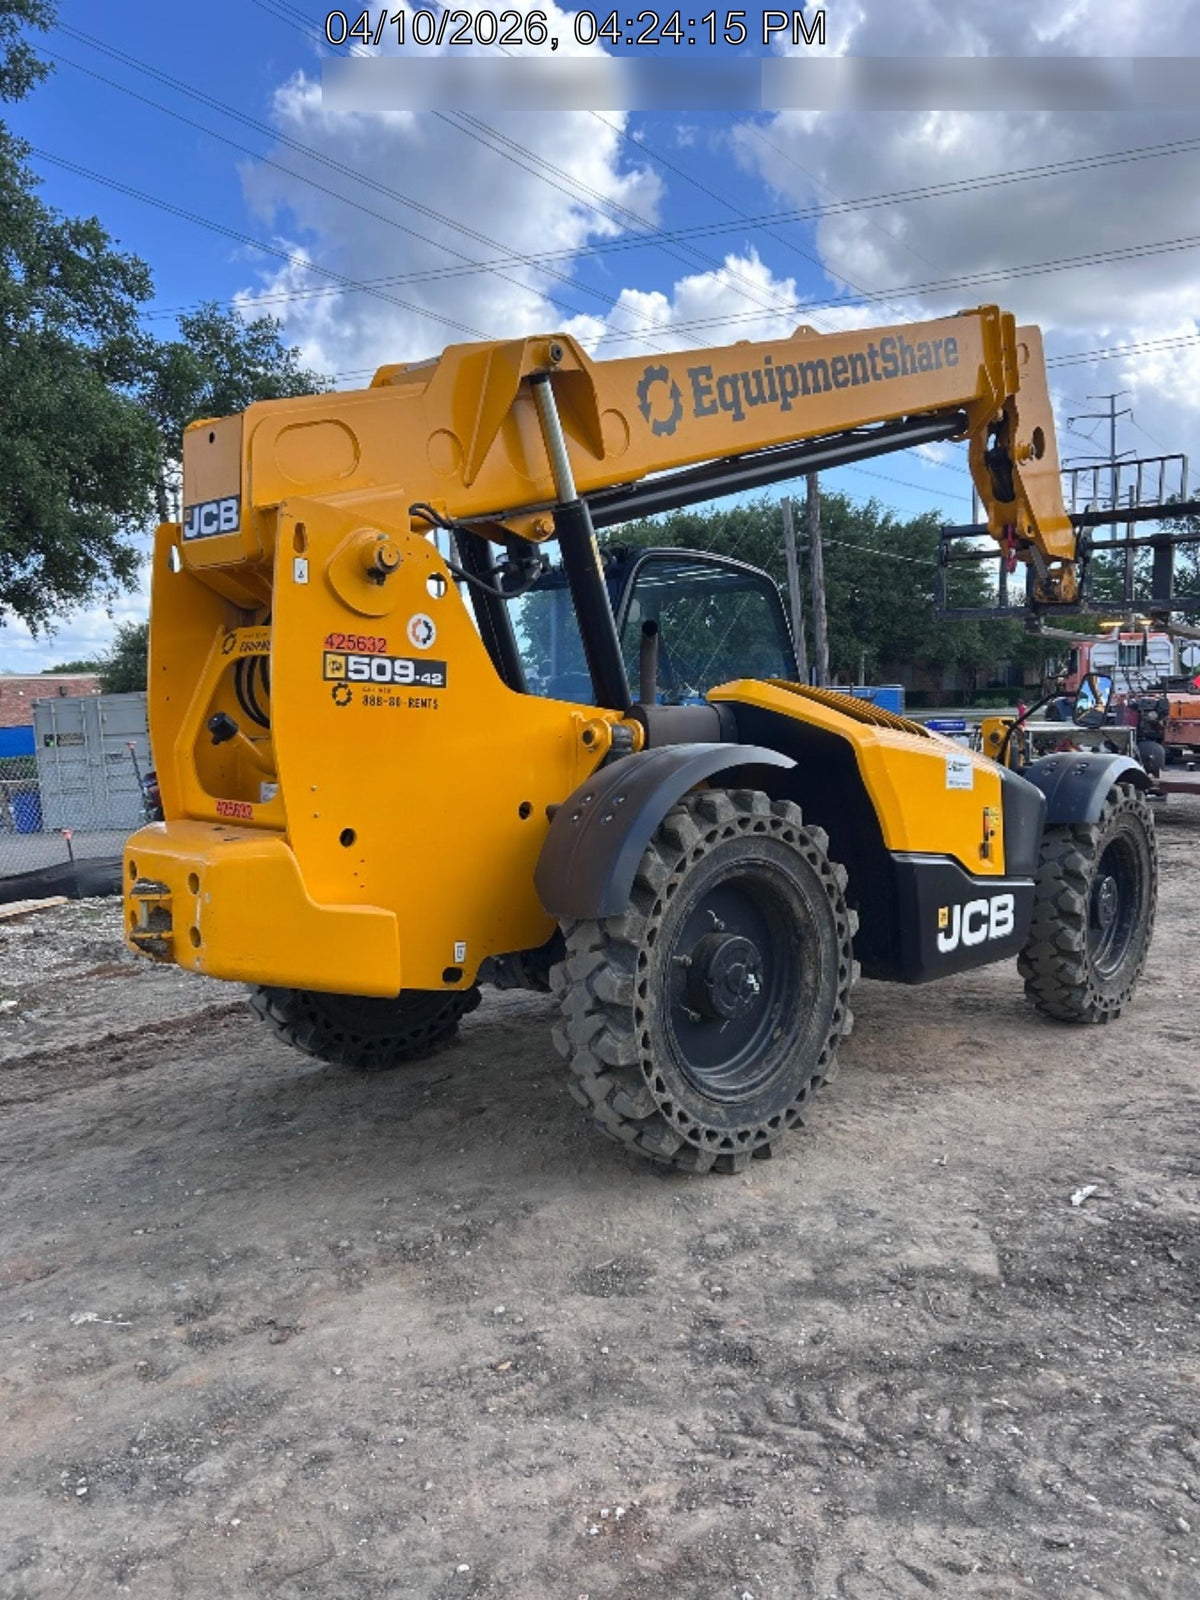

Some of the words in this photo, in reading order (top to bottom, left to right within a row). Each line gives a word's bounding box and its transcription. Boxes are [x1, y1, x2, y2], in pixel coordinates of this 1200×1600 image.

[688, 336, 959, 422] EquipmentShare
[184, 499, 239, 538] JCB
[325, 633, 387, 653] 425632
[937, 894, 1015, 953] JCB
